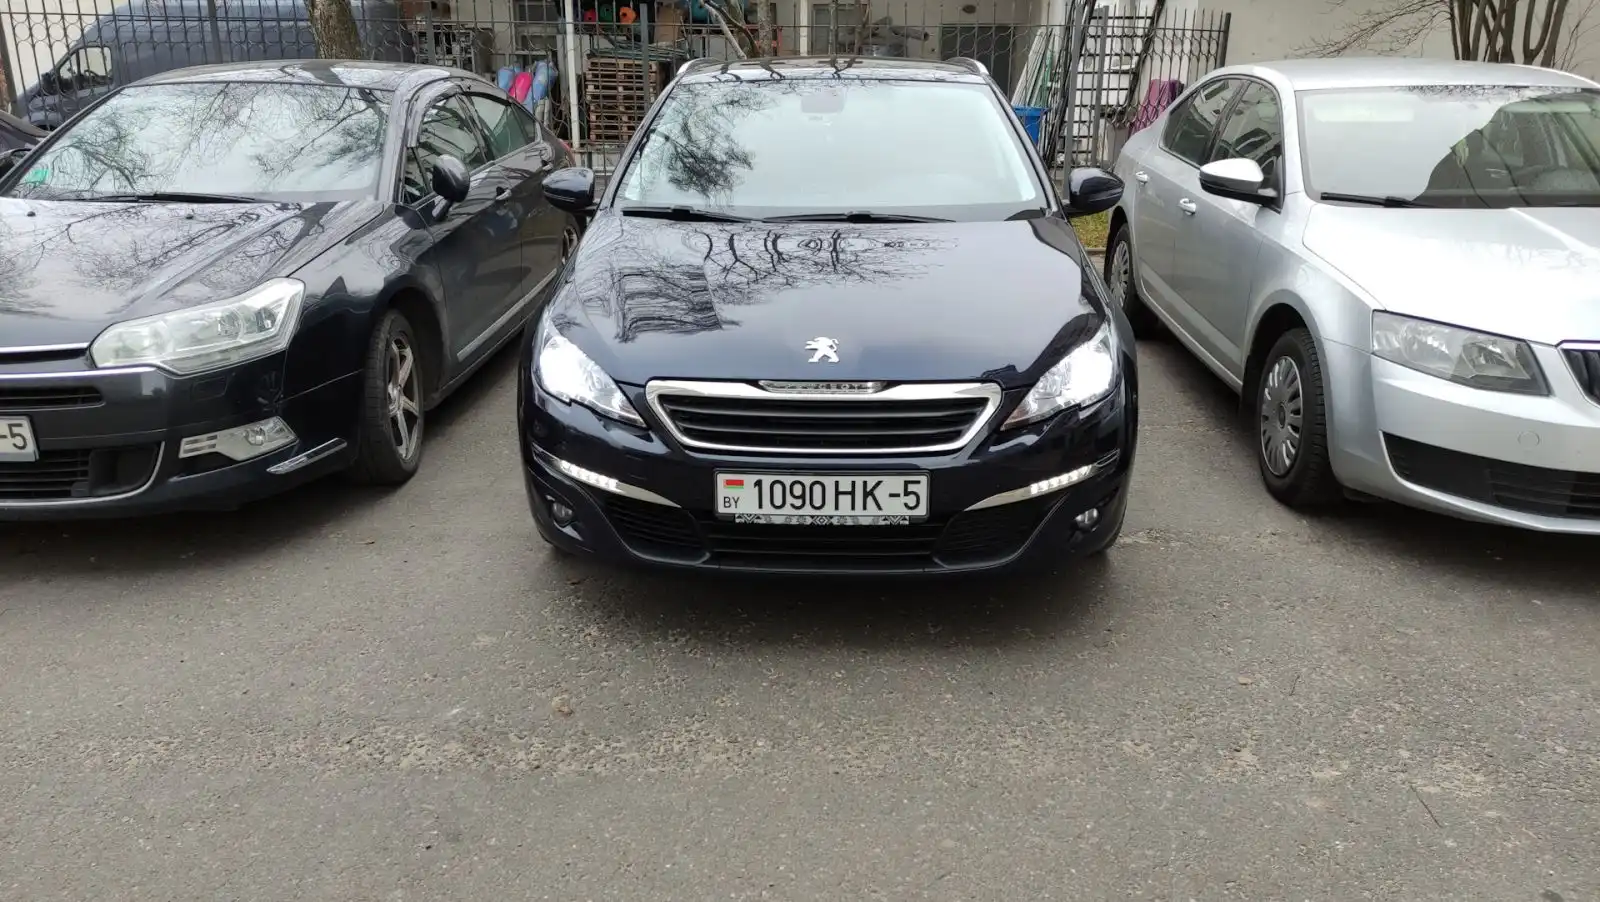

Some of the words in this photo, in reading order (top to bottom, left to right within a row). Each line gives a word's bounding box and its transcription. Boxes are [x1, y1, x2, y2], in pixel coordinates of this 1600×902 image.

[723, 496, 740, 509] BY
[753, 478, 827, 511] 1090
[834, 479, 922, 512] HK-5
